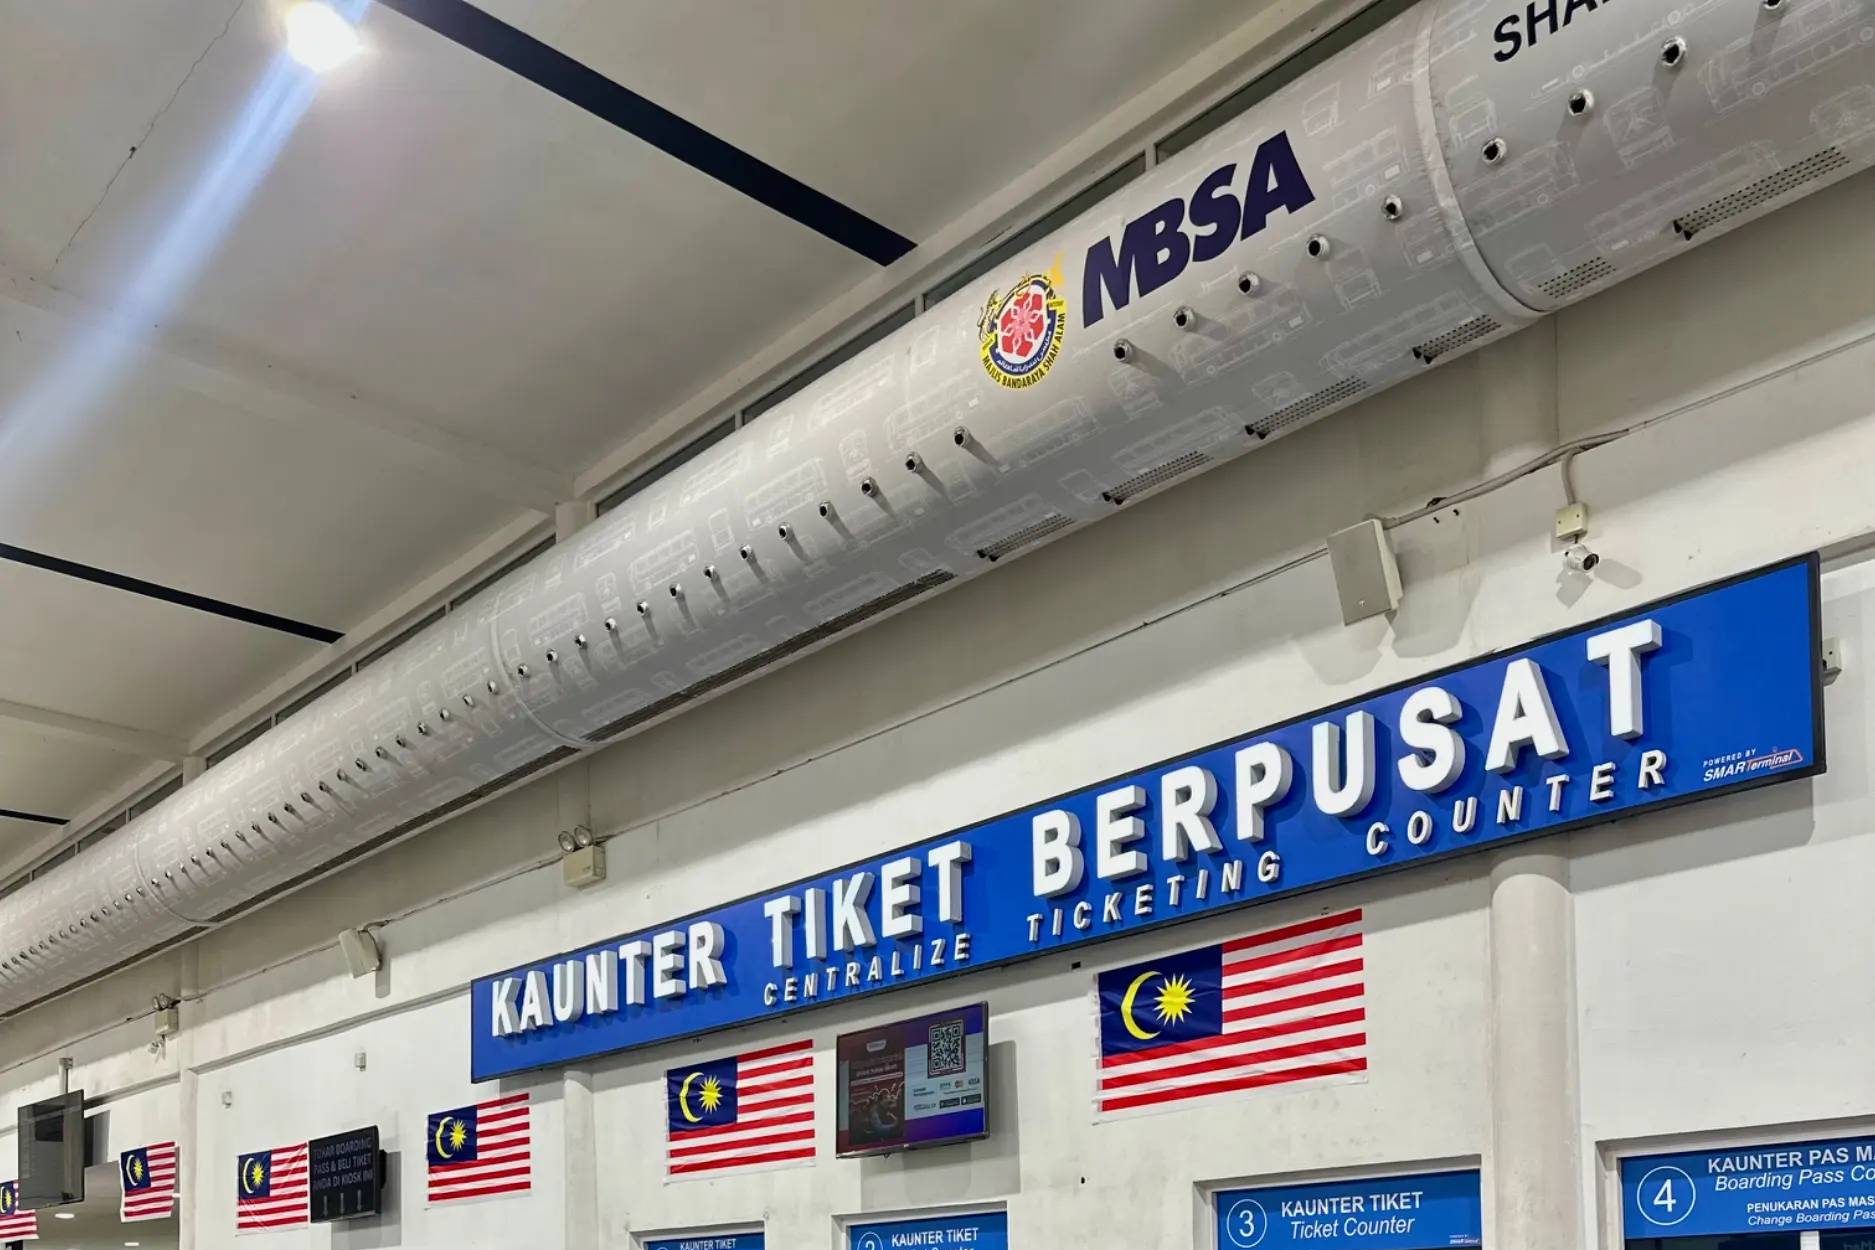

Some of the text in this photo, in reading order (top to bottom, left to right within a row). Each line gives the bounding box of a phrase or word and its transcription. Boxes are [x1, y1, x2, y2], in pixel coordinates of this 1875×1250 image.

[1083, 130, 1316, 328] MBSA
[1002, 368, 1046, 389] BANDARAYA
[1042, 345, 1060, 371] SHAH
[1055, 313, 1066, 343] ALAM
[1703, 748, 1757, 768] POWERED BY
[491, 618, 1663, 1038] KAUNTER TIKET BERPUSAT
[763, 749, 1667, 1007] CENTRALIZE TICKETING COUNTER
[313, 1137, 372, 1160] TUKAR BOARDING
[313, 1153, 372, 1174] PASS & BELI TIKET
[333, 1175, 340, 1187] DI
[341, 1172, 362, 1185] KIOSK
[1653, 1145, 1875, 1212] 4 KAUNTER PAS M
[1715, 1173, 1793, 1191] Boarding
[1798, 1168, 1844, 1185] Pass
[1239, 1191, 1423, 1237] 3 KAUNTER TIKET
[1747, 1195, 1875, 1213] PENUKARAN PAS MAS
[1291, 1217, 1415, 1239] Ticket Counter
[1748, 1215, 1792, 1227] Change
[1796, 1210, 1850, 1224] Boarding
[715, 1238, 737, 1249] TIKET
[891, 1230, 944, 1247] KAUNTER
[946, 1227, 979, 1242] TIKET
